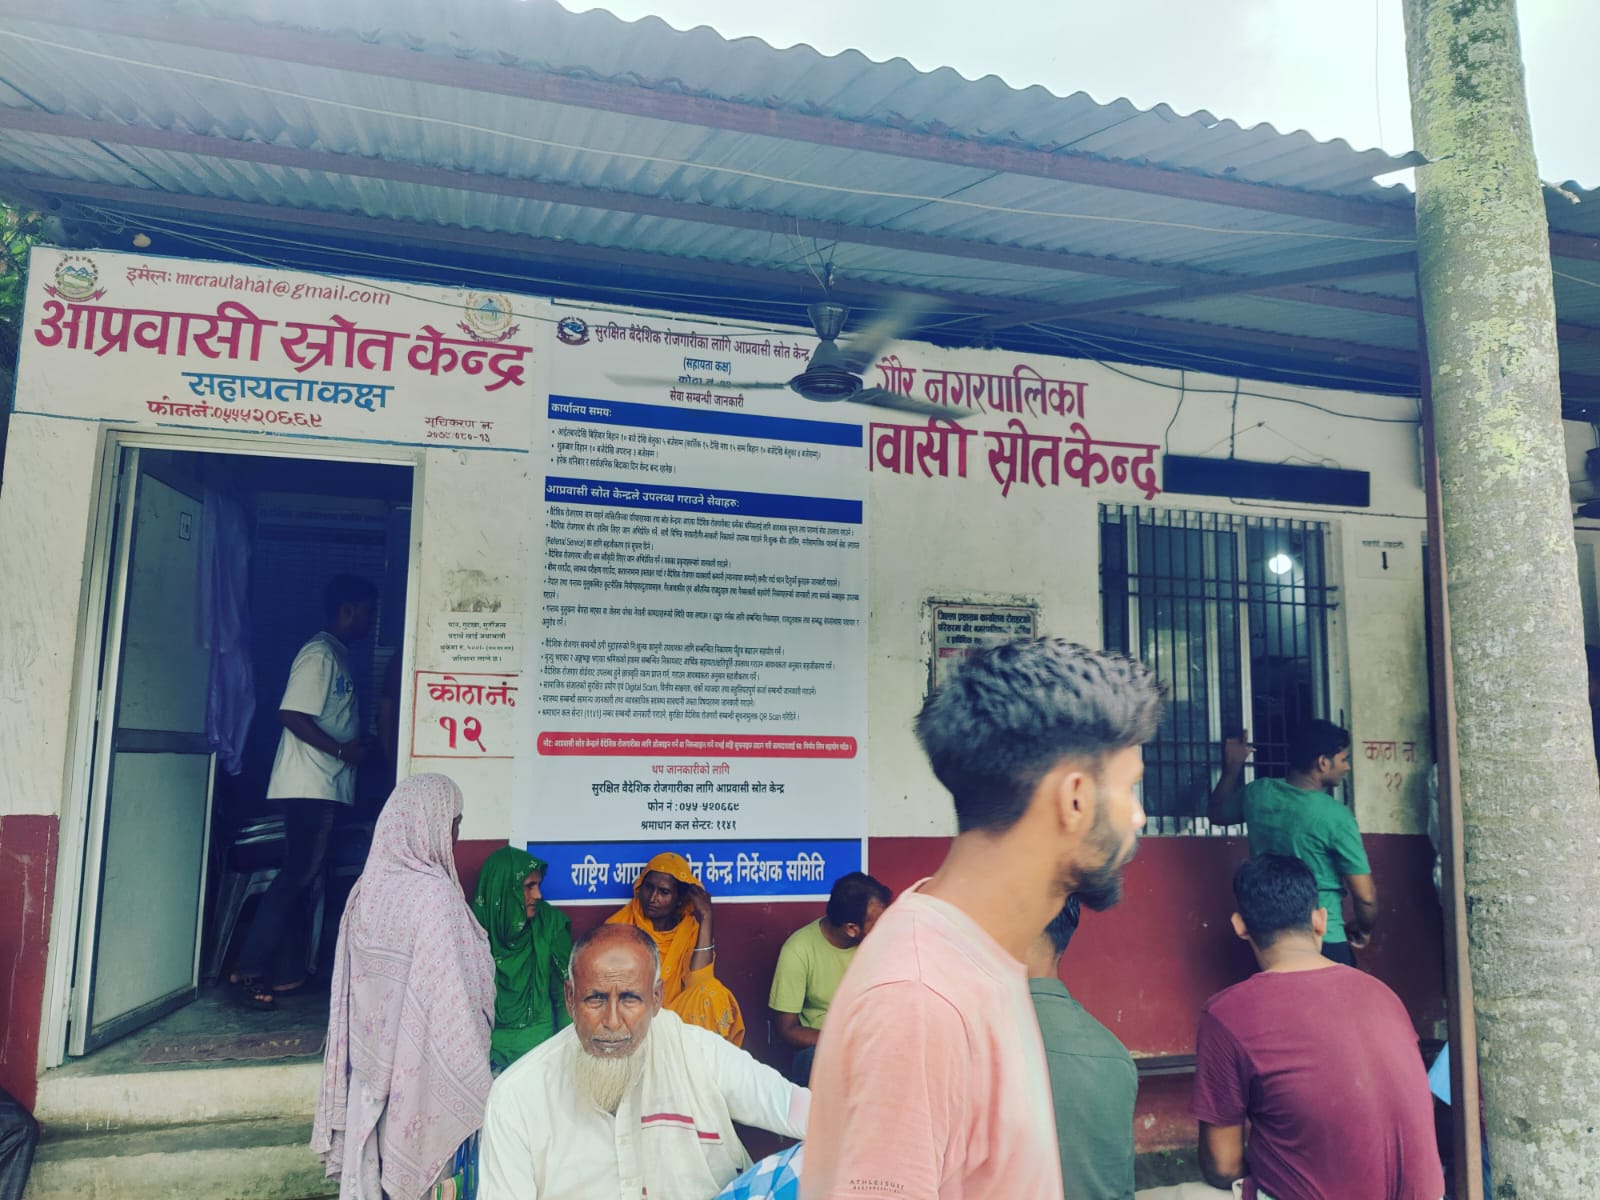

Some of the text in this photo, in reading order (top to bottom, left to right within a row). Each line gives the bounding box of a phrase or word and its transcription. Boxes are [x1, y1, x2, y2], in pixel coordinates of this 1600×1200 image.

[34, 301, 533, 392] आप्रवासी स्रोत केन्द्र
[595, 321, 810, 362] सुरक्षित वैदेशिक रोजगारीका लागि आप्रवासी स्रोत केन्द्र
[684, 357, 731, 376] (सहायता कक्ष)
[670, 386, 744, 408] सेवा सम्बन्धी जानकारी
[922, 364, 1088, 419] नगरपालिका
[551, 402, 587, 415] कार्यालय
[1064, 422, 1161, 500] केन्द्र
[546, 484, 588, 496] आप्रवासी
[591, 486, 610, 499] स्रोत
[613, 488, 640, 501] केन्द्रले
[642, 492, 674, 503] उपलब्ध
[677, 494, 704, 505] गराउने
[439, 716, 487, 752] १२
[652, 762, 730, 775] थप जानकारीको लागि
[592, 780, 785, 796] सुरक्षित वैदेशिक रोजगारीका लागि आप्रवासी स्रोत केन्द्र
[648, 798, 664, 811] फोन
[641, 820, 672, 830] श्रमाधान
[674, 820, 689, 830] कल
[717, 820, 737, 831] ११४१
[571, 855, 609, 892] राष्ट्रिय
[706, 853, 733, 884] केन्द्र
[736, 853, 783, 884] निर्देशक
[786, 852, 825, 882] समिति
